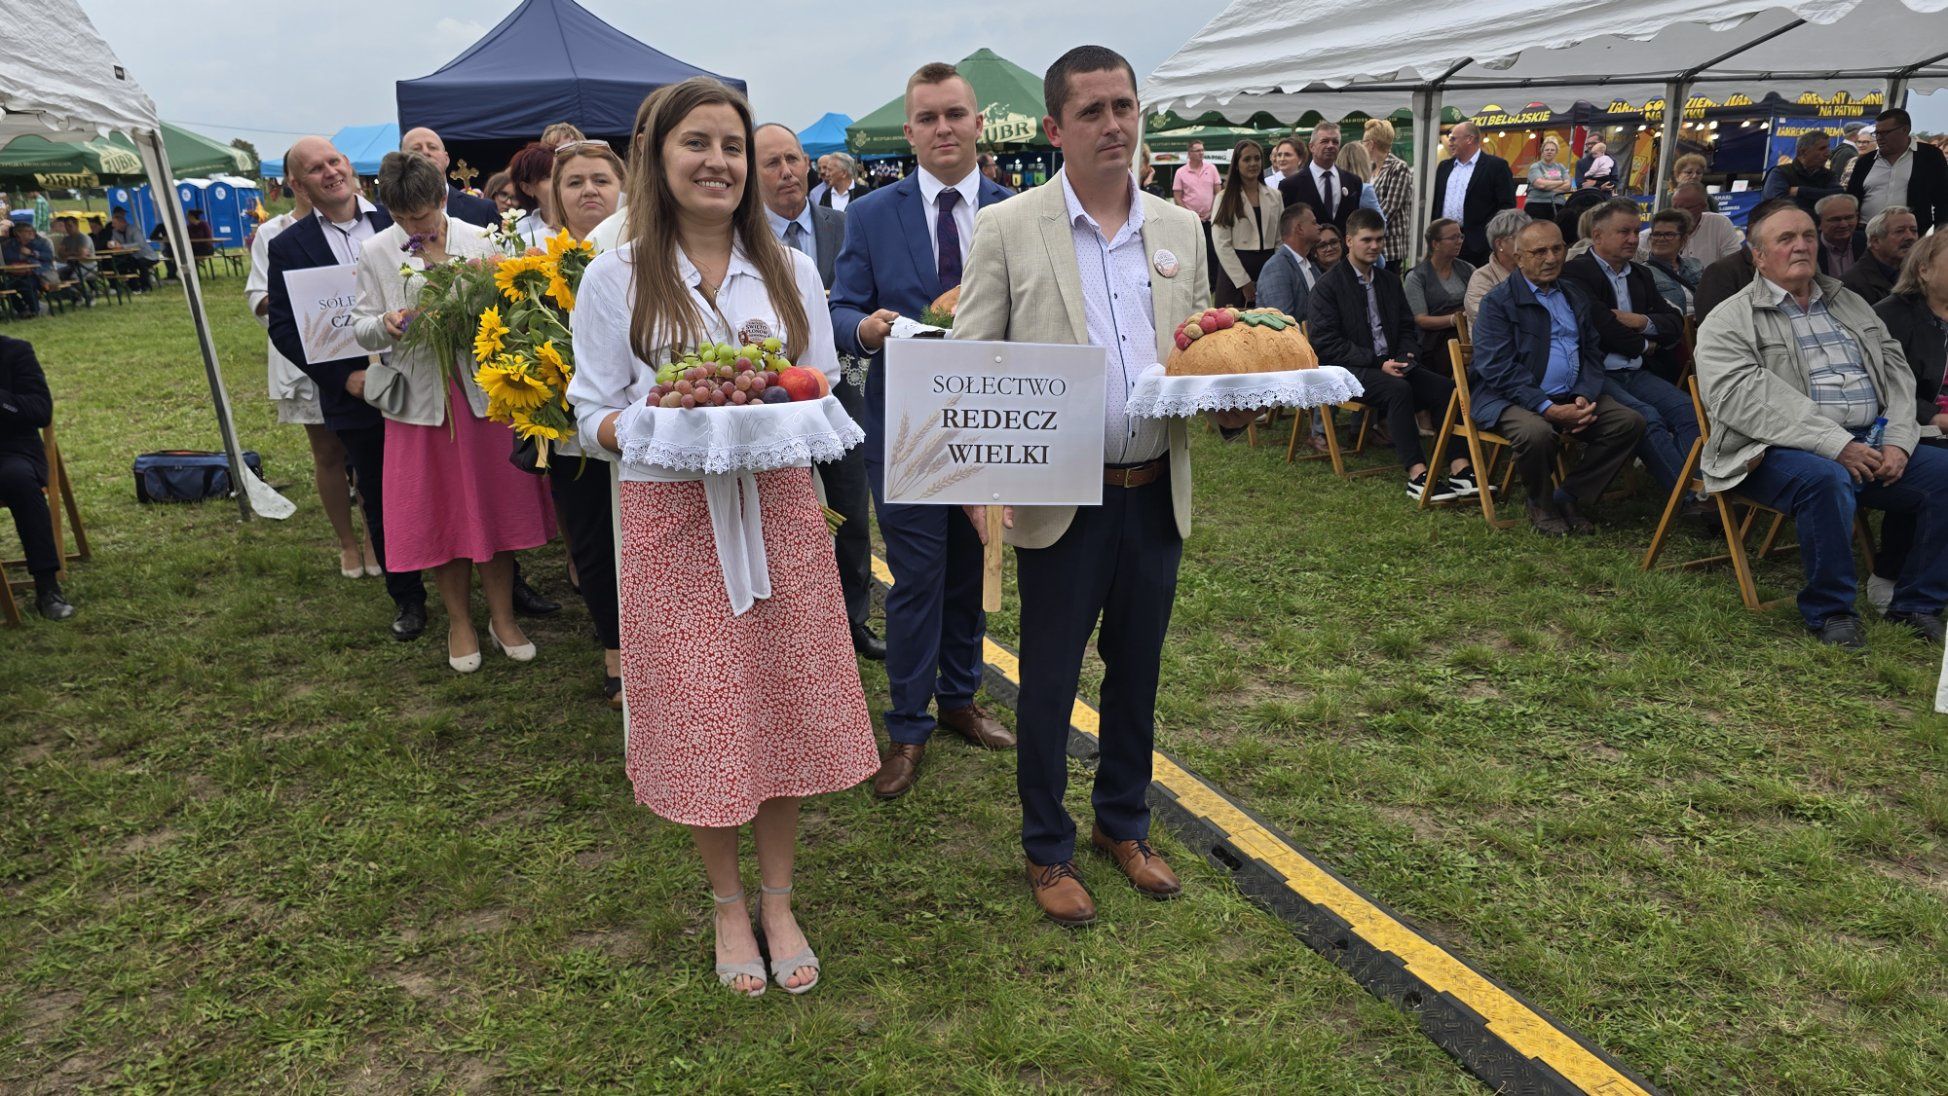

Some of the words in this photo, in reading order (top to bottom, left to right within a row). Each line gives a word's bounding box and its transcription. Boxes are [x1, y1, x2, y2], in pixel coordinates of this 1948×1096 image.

[1471, 116, 1488, 127] TKI
[1487, 110, 1551, 126] BELGIJSKIE
[1834, 105, 1864, 117] PATYKU
[985, 122, 1031, 142] UBR
[331, 314, 354, 328] CZ
[933, 375, 1066, 396] SOŁECTWO
[941, 408, 1058, 430] REDECZ
[947, 444, 1049, 465] WIELKI
